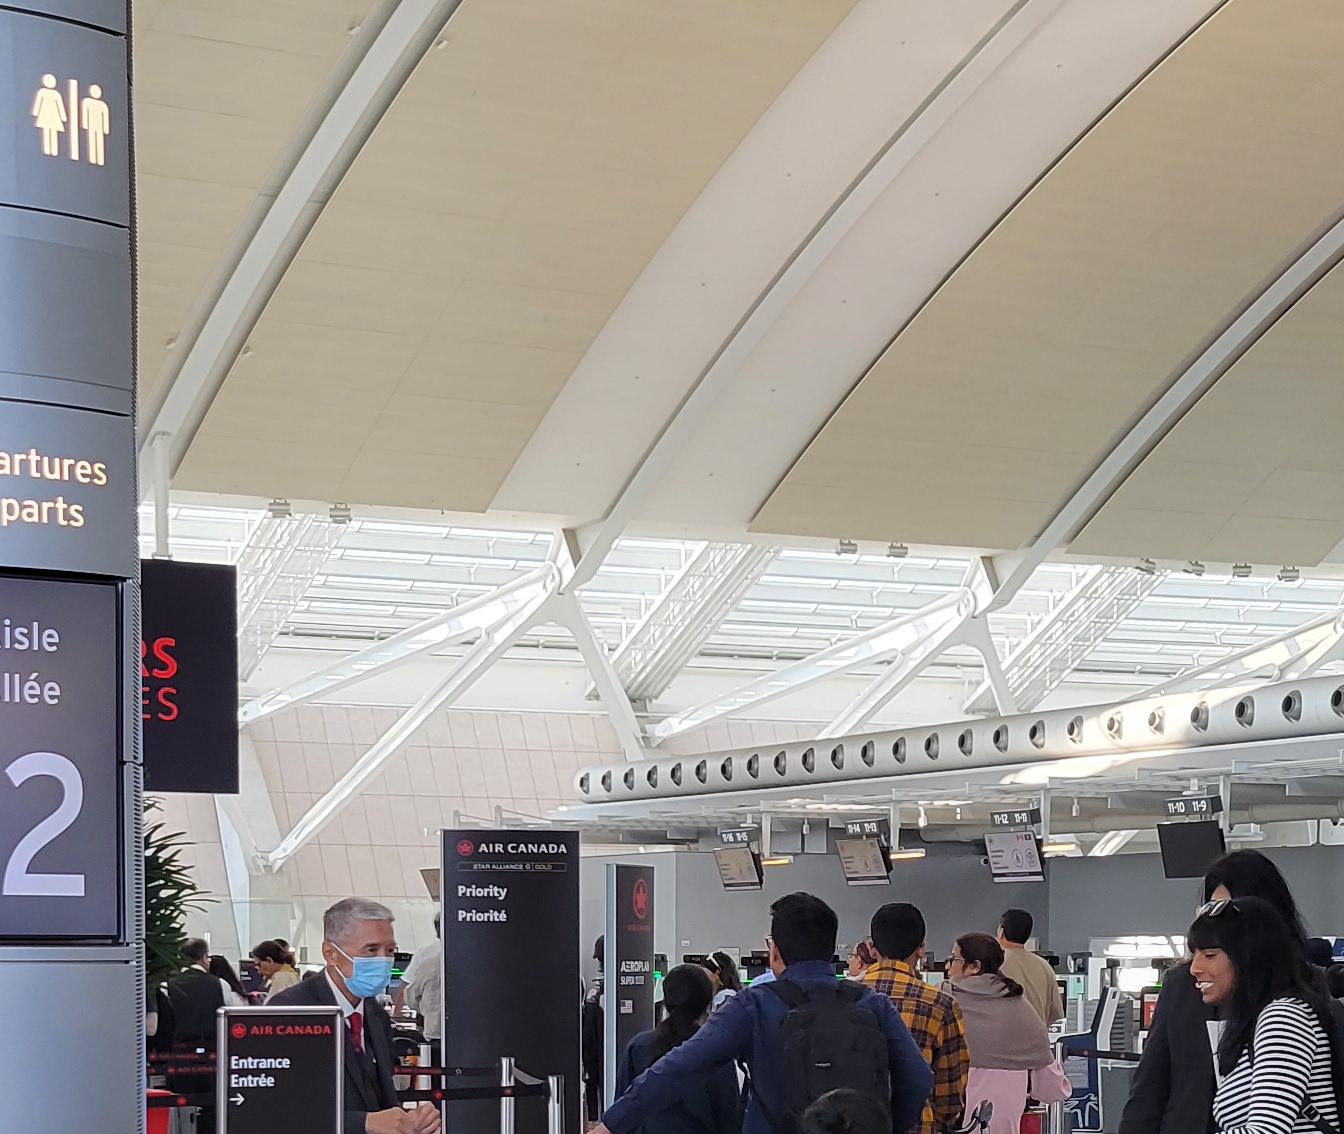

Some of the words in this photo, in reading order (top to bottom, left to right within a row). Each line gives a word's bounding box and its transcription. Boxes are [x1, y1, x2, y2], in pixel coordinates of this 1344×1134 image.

[1168, 802, 1185, 813] 11-10
[1191, 800, 1206, 811] 11-9
[994, 814, 1009, 824] 11-12
[478, 843, 505, 853] AIR
[507, 843, 568, 854] CANADA
[457, 884, 507, 900] Priority
[458, 910, 507, 921] Priorité
[251, 1025, 273, 1035] AIR
[276, 1025, 332, 1035] CANADA
[230, 1056, 291, 1069] Entrance
[230, 1073, 276, 1088] Entrée
